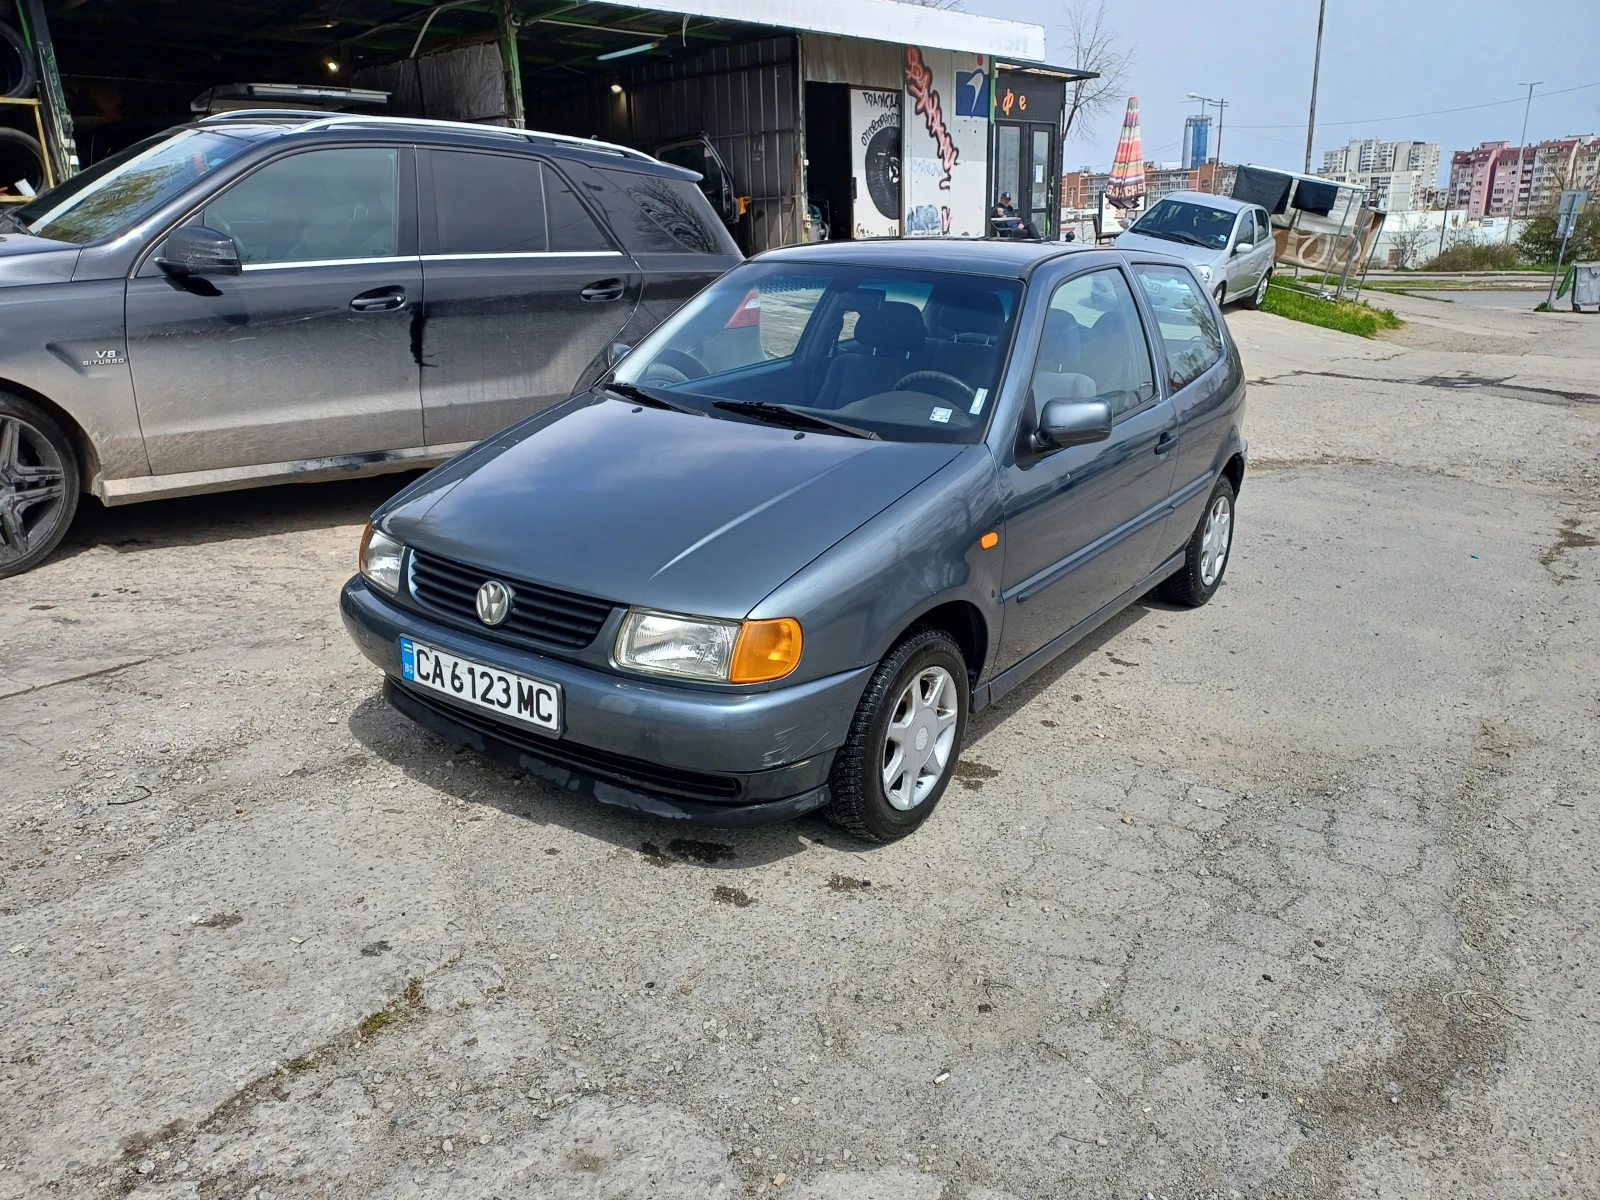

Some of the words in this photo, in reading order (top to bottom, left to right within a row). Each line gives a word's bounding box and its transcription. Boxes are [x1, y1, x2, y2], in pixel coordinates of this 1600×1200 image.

[95, 350, 116, 358] V8
[83, 358, 125, 366] BITURBO
[404, 662, 414, 674] BG
